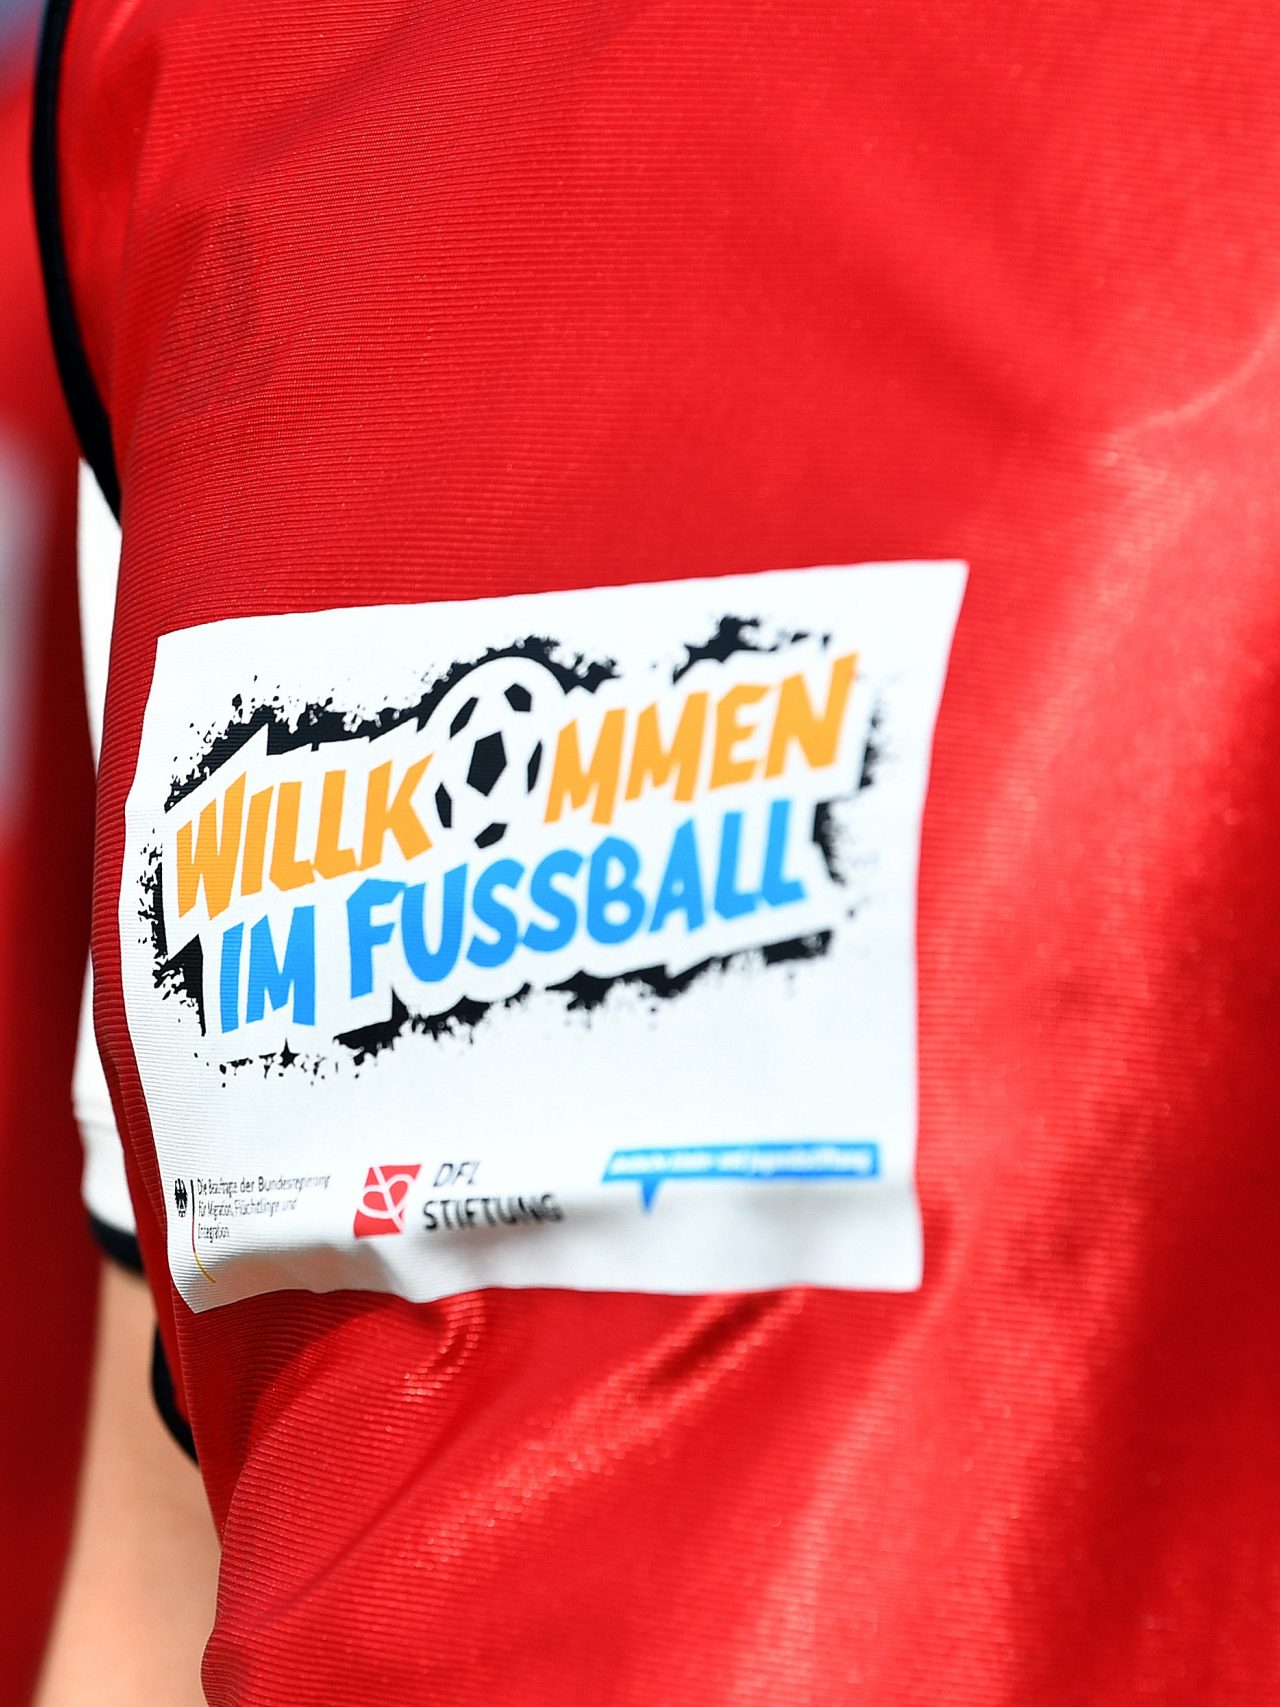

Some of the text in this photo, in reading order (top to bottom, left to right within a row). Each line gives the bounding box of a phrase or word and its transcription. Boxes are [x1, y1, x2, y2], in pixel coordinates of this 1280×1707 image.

[220, 799, 808, 1034] IM FUSSBALL
[240, 1177, 255, 1193] der
[423, 1193, 564, 1230] STIFTUNG
